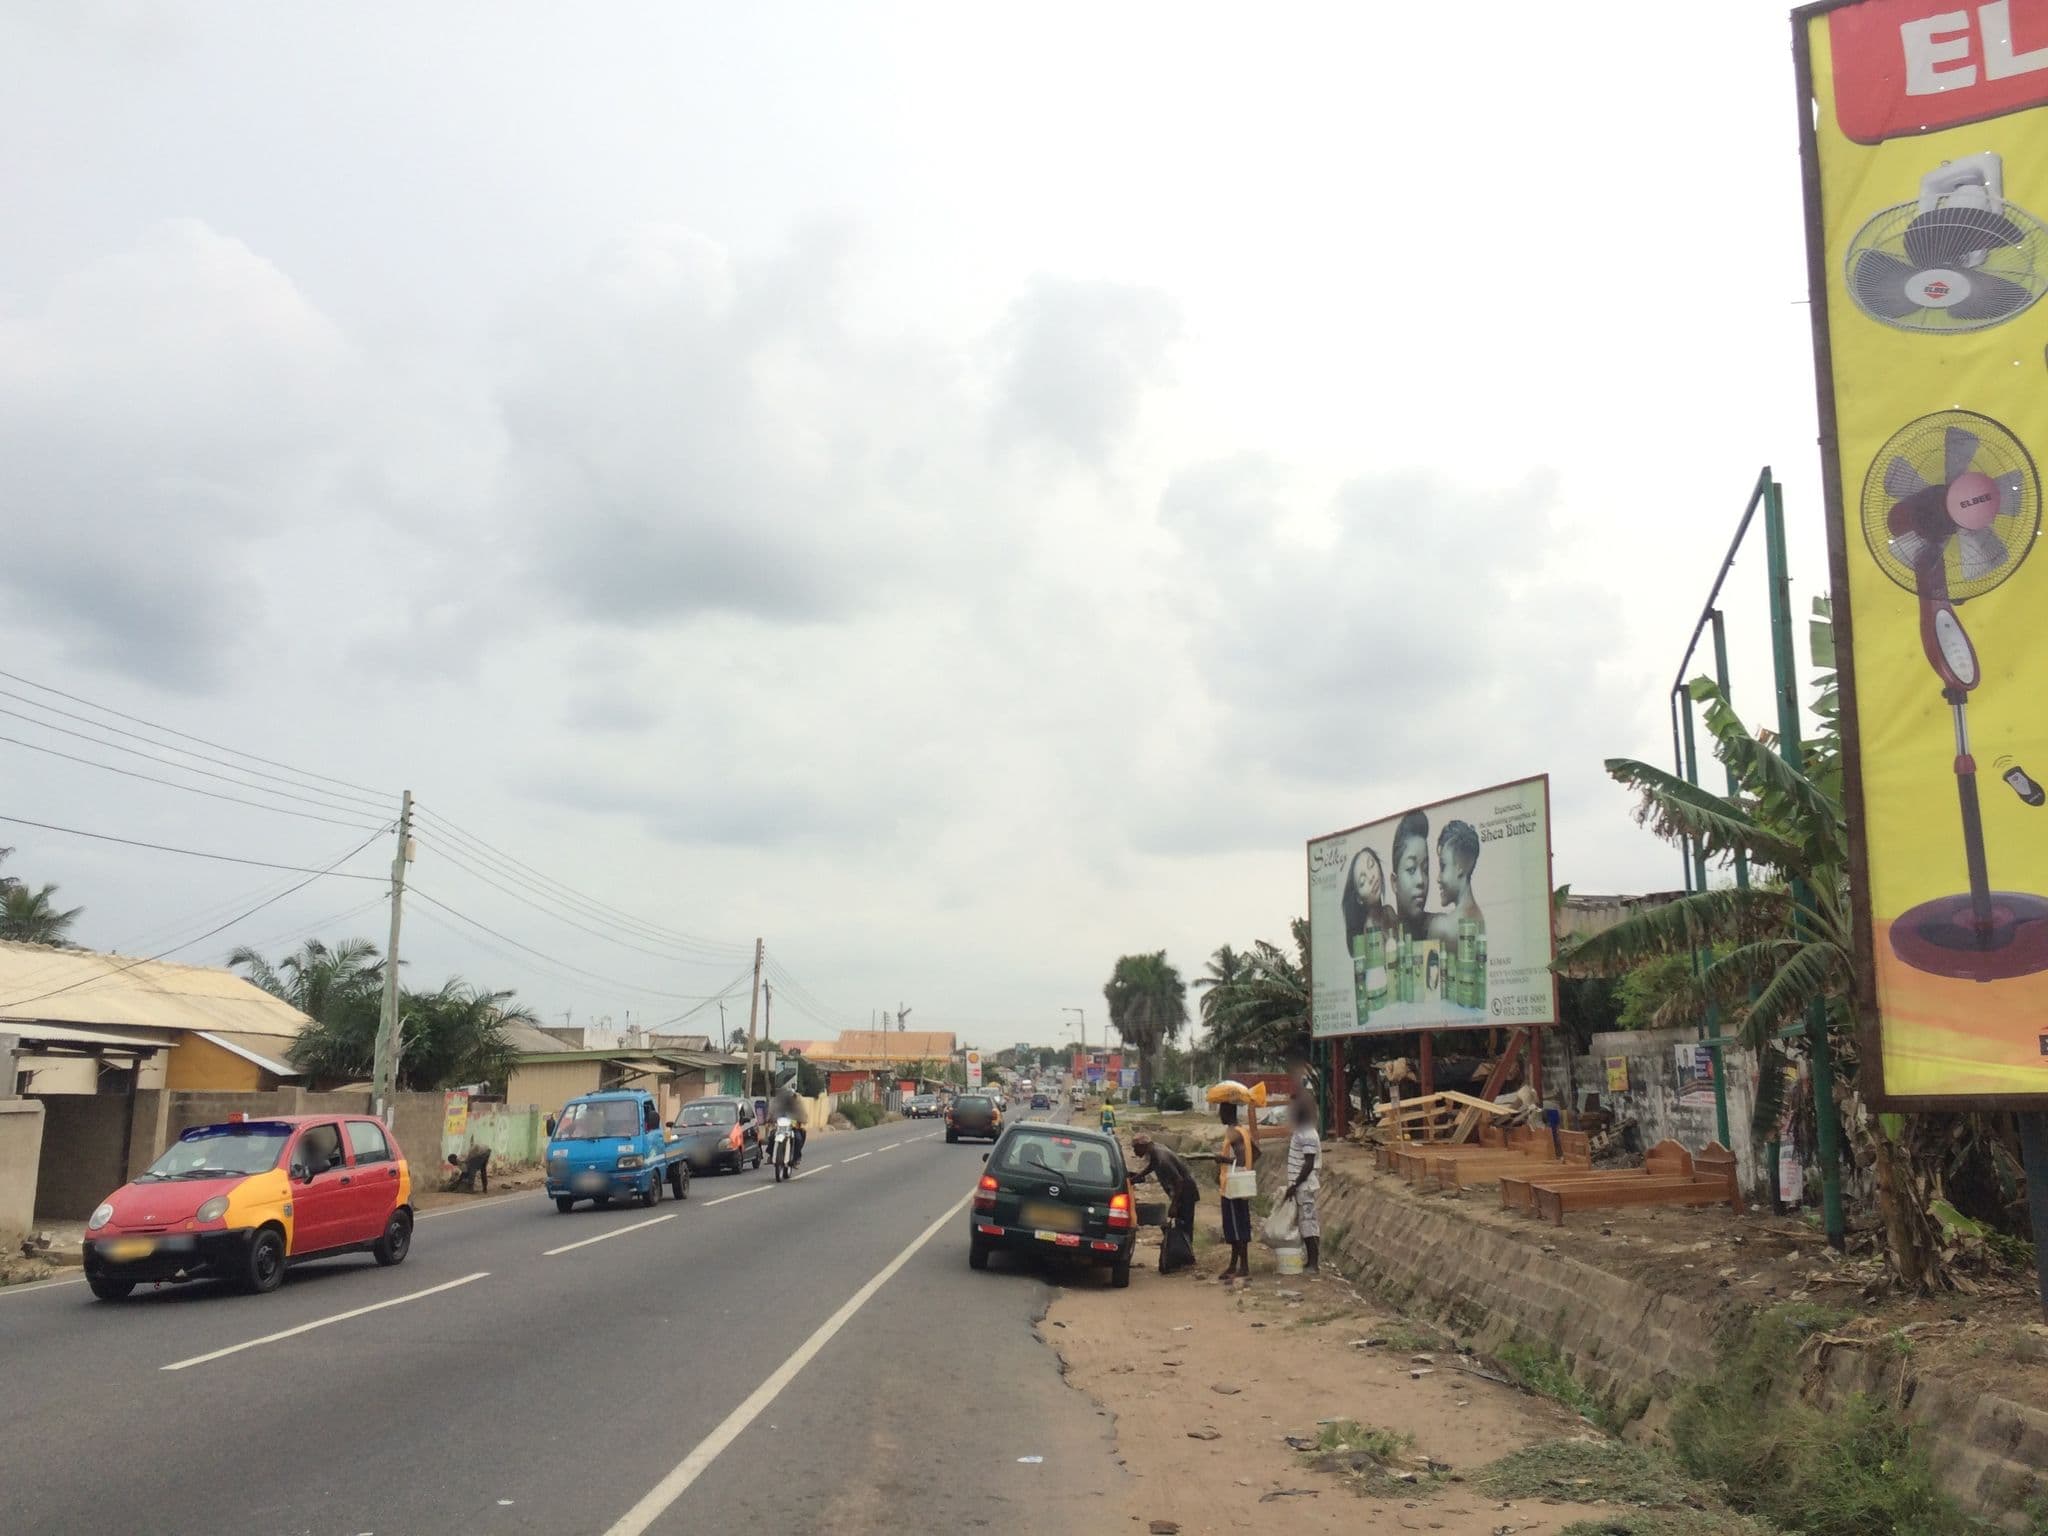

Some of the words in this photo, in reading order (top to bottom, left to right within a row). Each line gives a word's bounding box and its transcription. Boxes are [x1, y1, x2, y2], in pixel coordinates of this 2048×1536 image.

[1960, 493, 1992, 508] ELBEE
[1481, 829, 1504, 843] Shea
[1506, 822, 1537, 837] Butter
[1310, 847, 1347, 873] Silky
